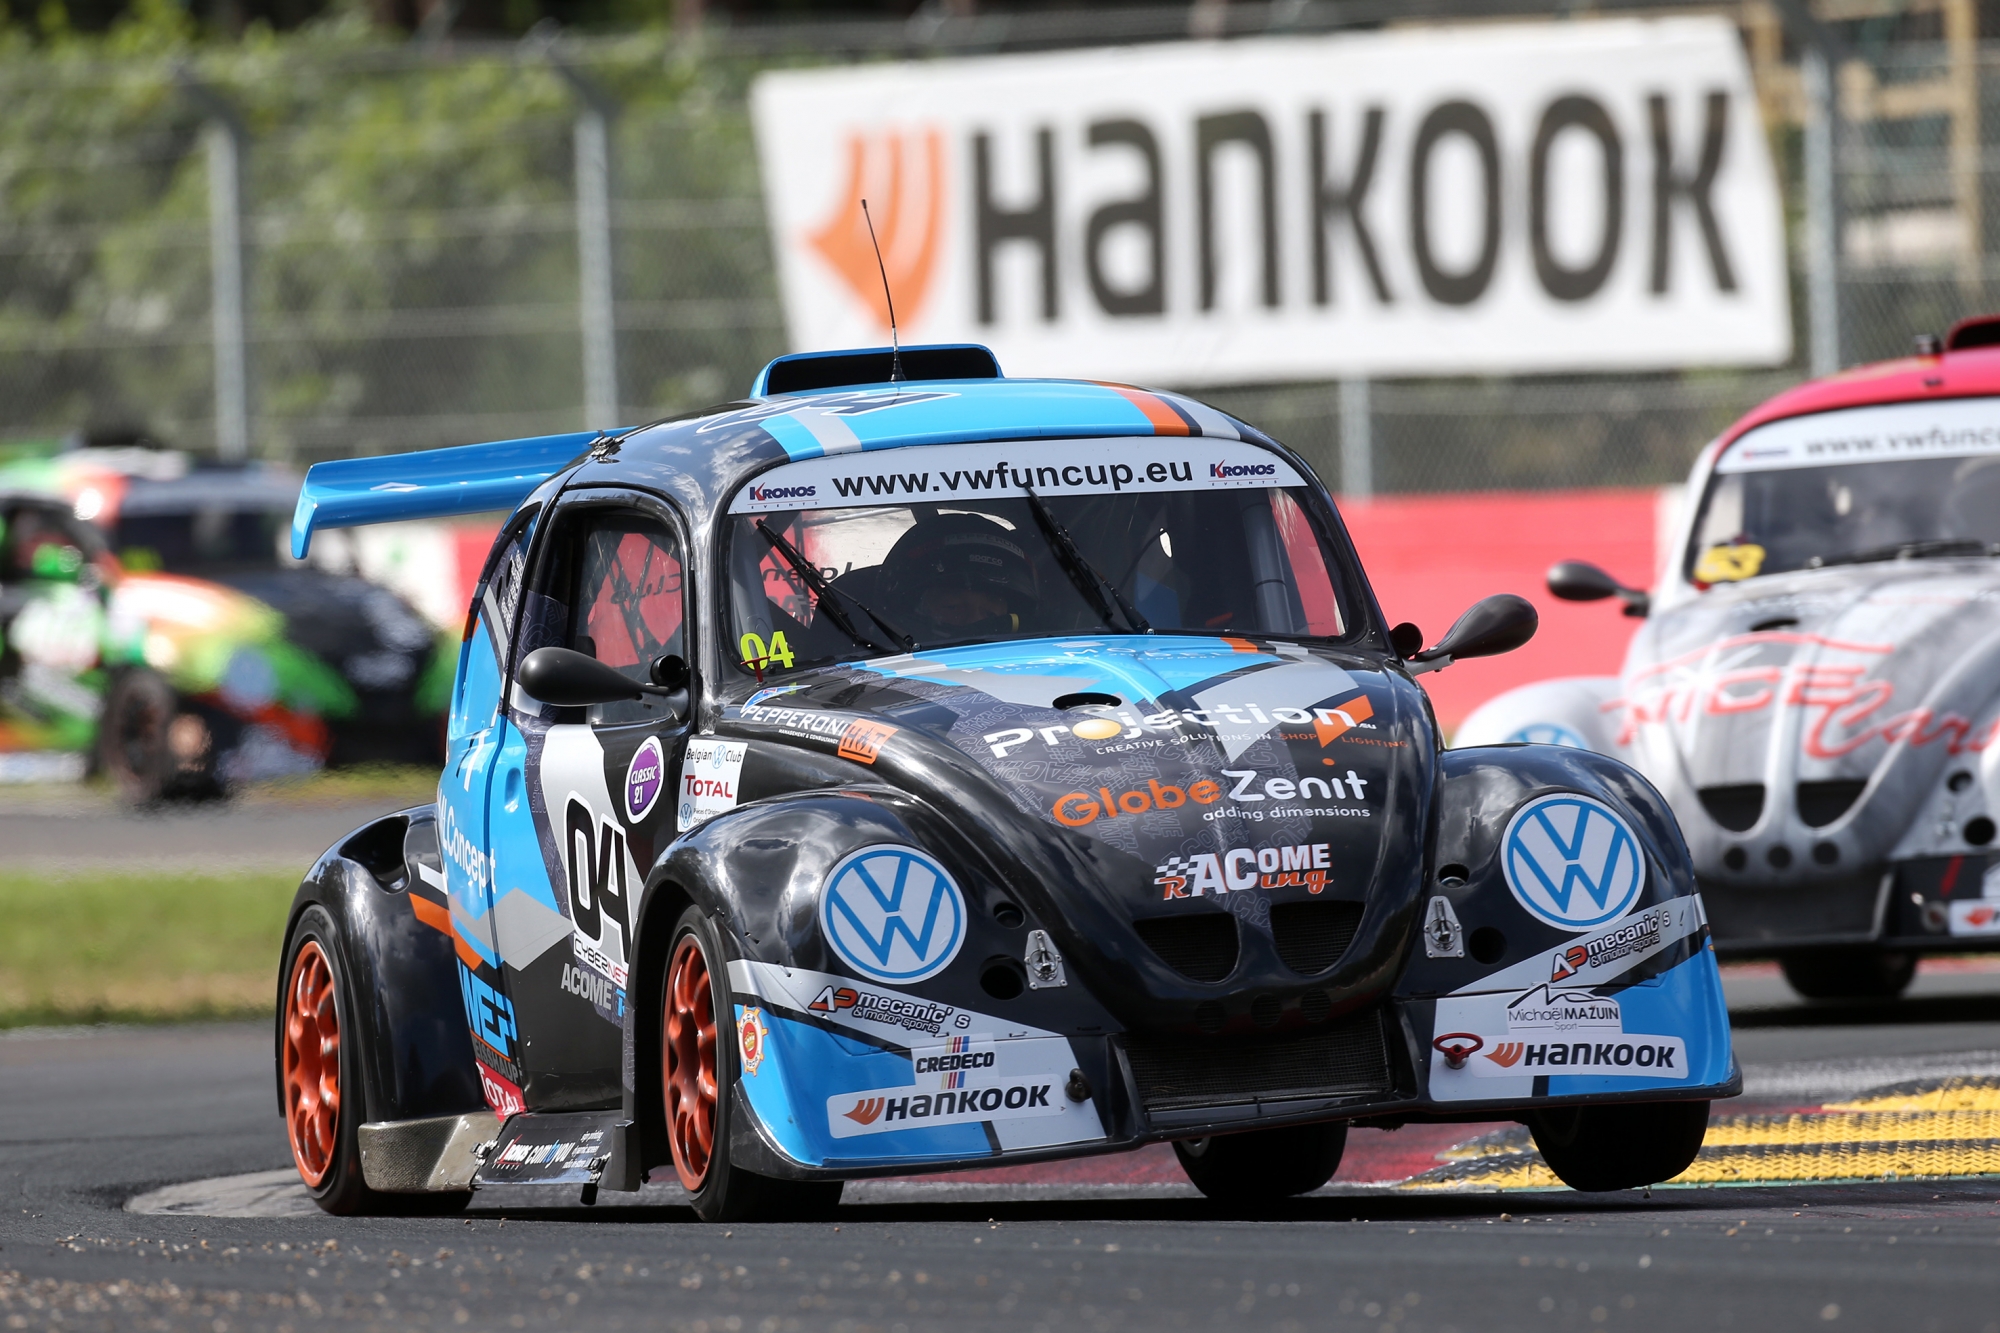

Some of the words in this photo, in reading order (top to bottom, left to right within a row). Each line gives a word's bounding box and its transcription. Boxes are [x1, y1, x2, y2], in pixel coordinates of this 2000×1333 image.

[832, 460, 1194, 498] www.vwfuncup.eu
[1209, 459, 1276, 479] KRONOS
[749, 482, 817, 501] KRONOS
[741, 631, 795, 670] 04
[741, 706, 849, 737] PEPPERONI
[686, 747, 713, 763] Belgian
[725, 749, 742, 763] Club
[1096, 739, 1166, 755] CREATIVE
[1169, 732, 1252, 746] SOLUTIONS
[1255, 732, 1272, 741] IN
[1278, 732, 1318, 742] SHOP
[1340, 735, 1410, 749] LIGHTING
[630, 765, 658, 786] CLASSIC
[633, 785, 644, 805] 21
[1202, 805, 1264, 822] adding
[1269, 804, 1371, 818] dimensions
[564, 791, 633, 966] 04
[561, 962, 613, 1011] ACOME
[865, 1008, 901, 1025] motor
[902, 1016, 941, 1034] sports
[1554, 1021, 1578, 1033] Sport
[915, 1051, 995, 1075] CREDECO
